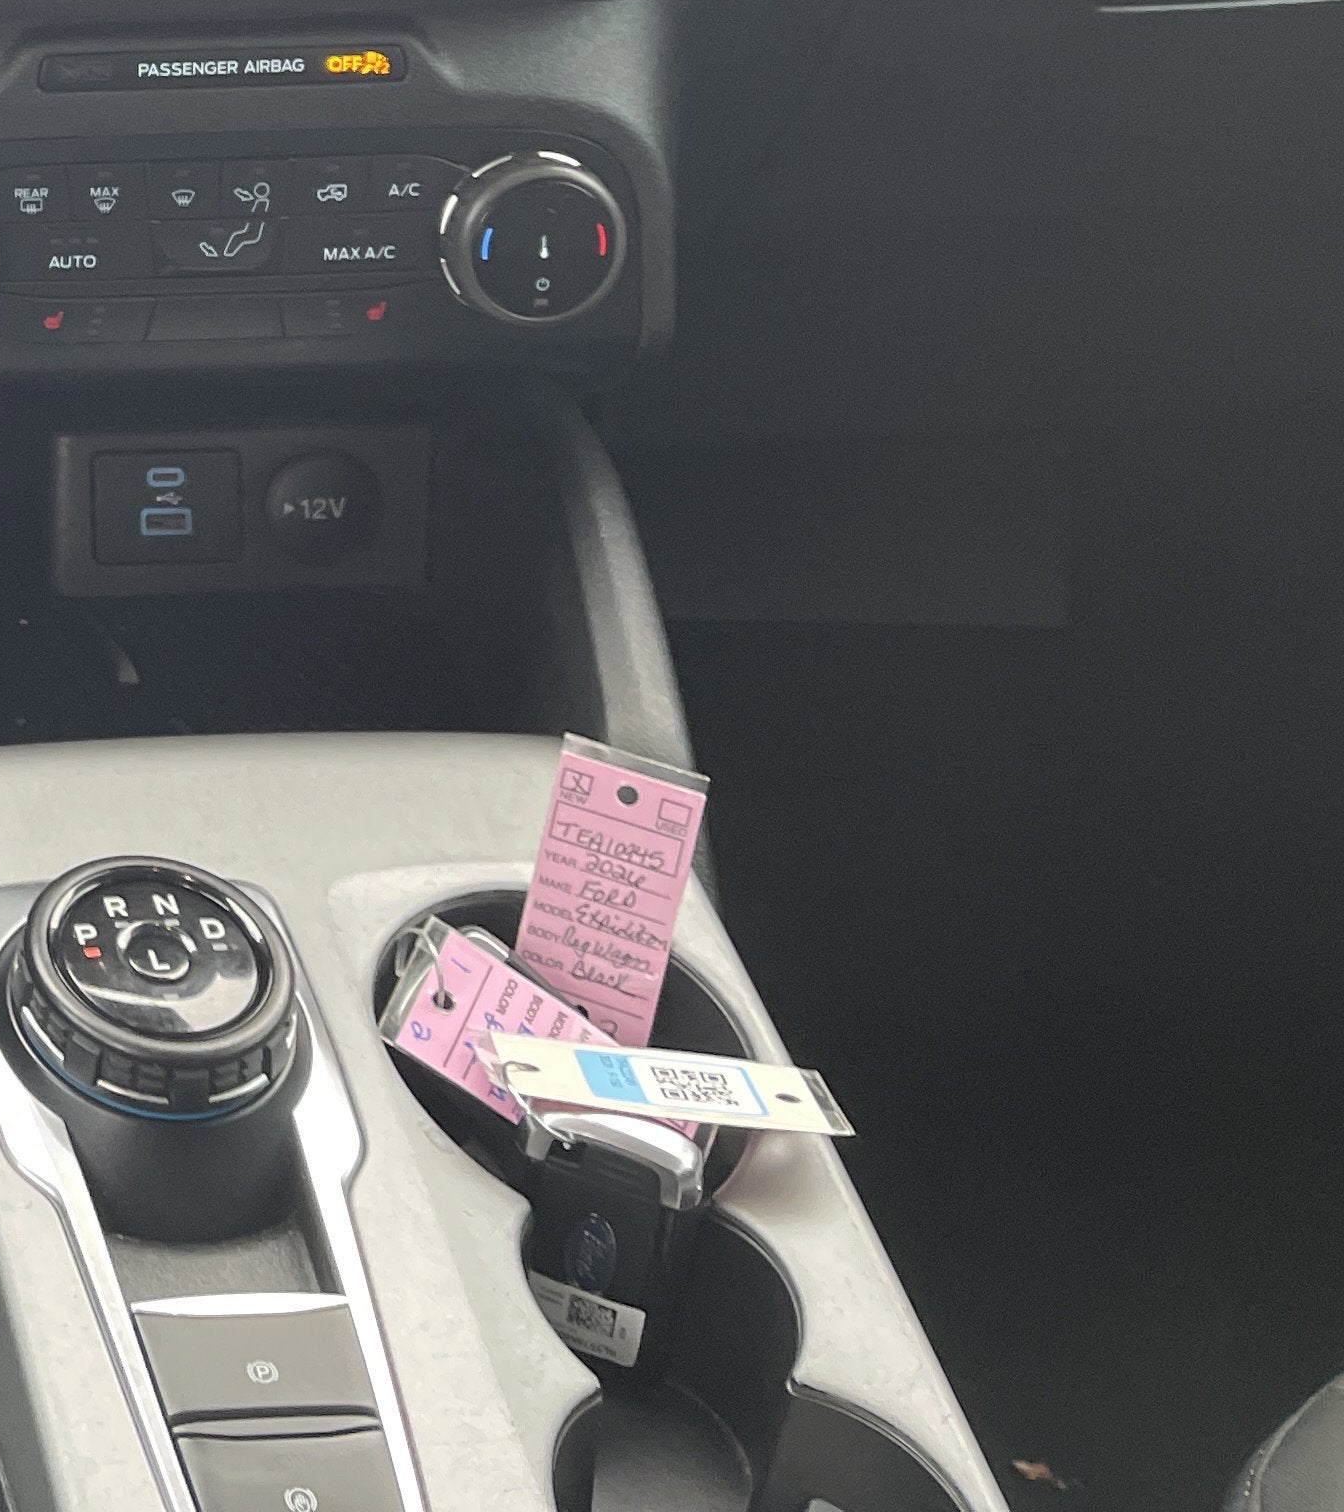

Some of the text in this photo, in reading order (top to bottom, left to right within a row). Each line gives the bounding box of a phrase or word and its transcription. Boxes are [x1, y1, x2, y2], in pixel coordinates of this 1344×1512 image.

[137, 53, 362, 79] PASSENGER AIRBAG OFF
[14, 182, 421, 199] REAR MAX A/C
[48, 244, 396, 270] AUTO MAX A/C
[300, 496, 346, 521] 12V
[559, 790, 588, 806] NEW
[655, 819, 688, 838] USED
[543, 847, 578, 869] YEAR
[538, 873, 573, 896] MAKE
[103, 895, 129, 919] R
[152, 893, 180, 917] N
[532, 899, 575, 923] MODEL
[73, 922, 98, 948] P
[201, 916, 225, 941] D
[526, 923, 562, 946] BODY
[149, 948, 171, 971] L
[521, 949, 564, 972] COLOR
[495, 978, 519, 1017] COLOR
[523, 993, 543, 1027] BODY
